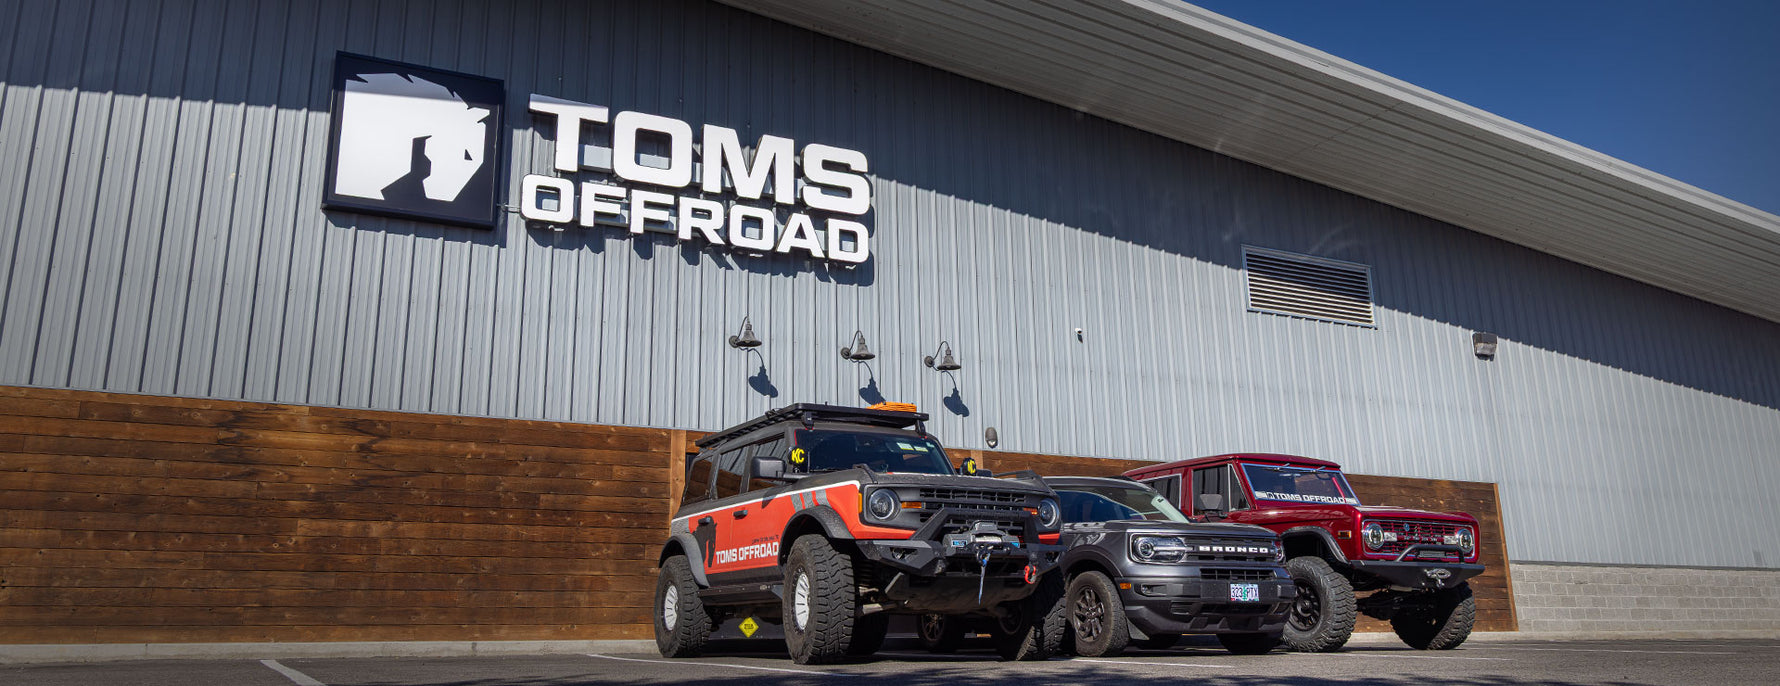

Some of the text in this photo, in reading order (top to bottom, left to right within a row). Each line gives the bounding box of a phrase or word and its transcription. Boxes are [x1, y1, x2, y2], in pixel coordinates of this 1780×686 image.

[528, 93, 871, 216] TOMS
[520, 174, 870, 264] OFFROAD
[791, 448, 805, 464] KC
[1273, 492, 1346, 504] TOMS OFFROAD
[716, 541, 779, 565] TOMS OFFROAD
[1199, 545, 1269, 554] BRONCO
